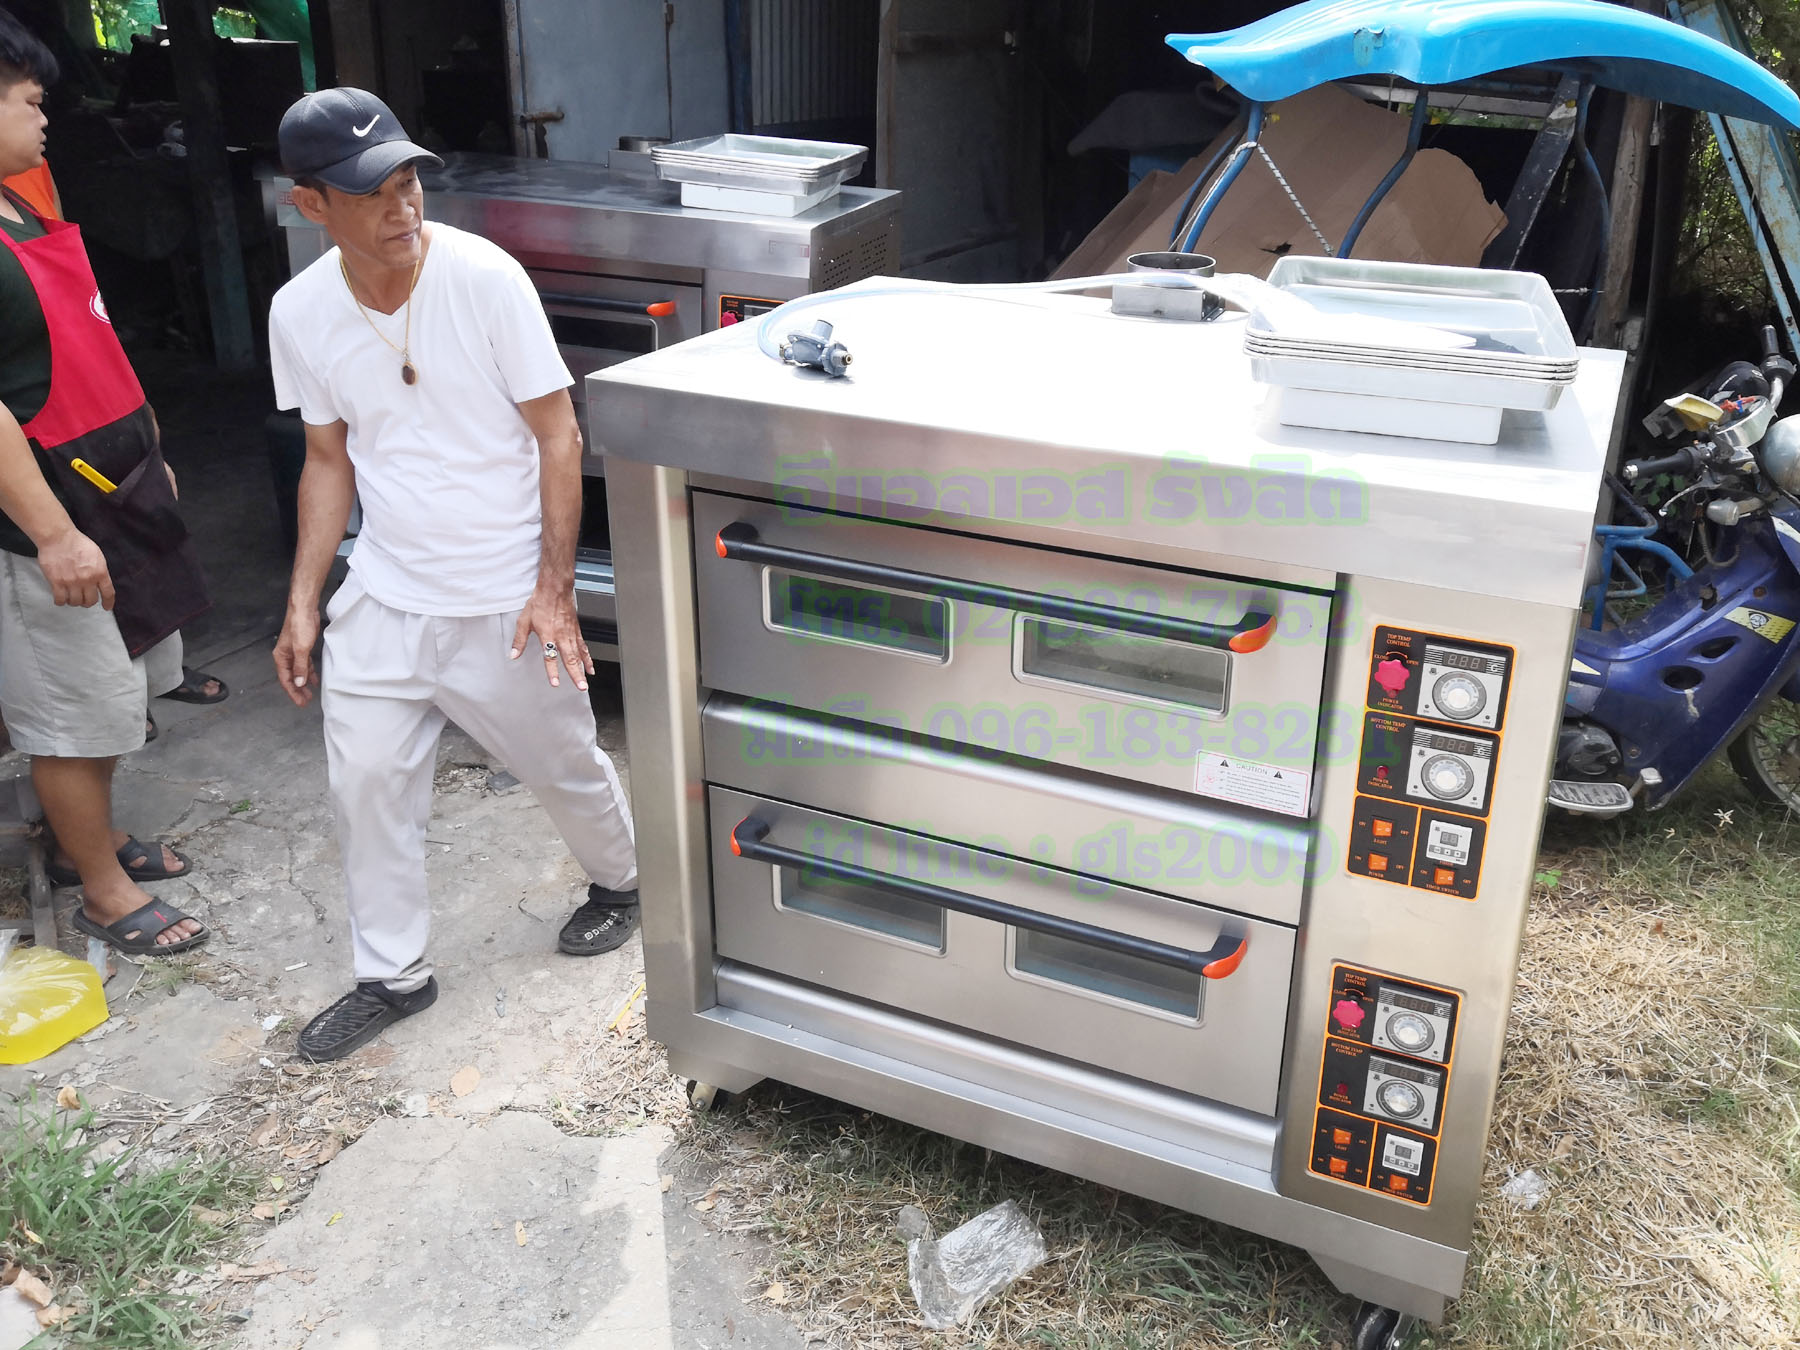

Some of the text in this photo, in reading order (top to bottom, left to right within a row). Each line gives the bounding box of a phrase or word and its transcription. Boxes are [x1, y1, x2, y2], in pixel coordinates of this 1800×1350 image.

[1386, 639, 1411, 647] CONTROL
[1375, 723, 1400, 733] CONTROL
[1236, 762, 1268, 775] CAUTION
